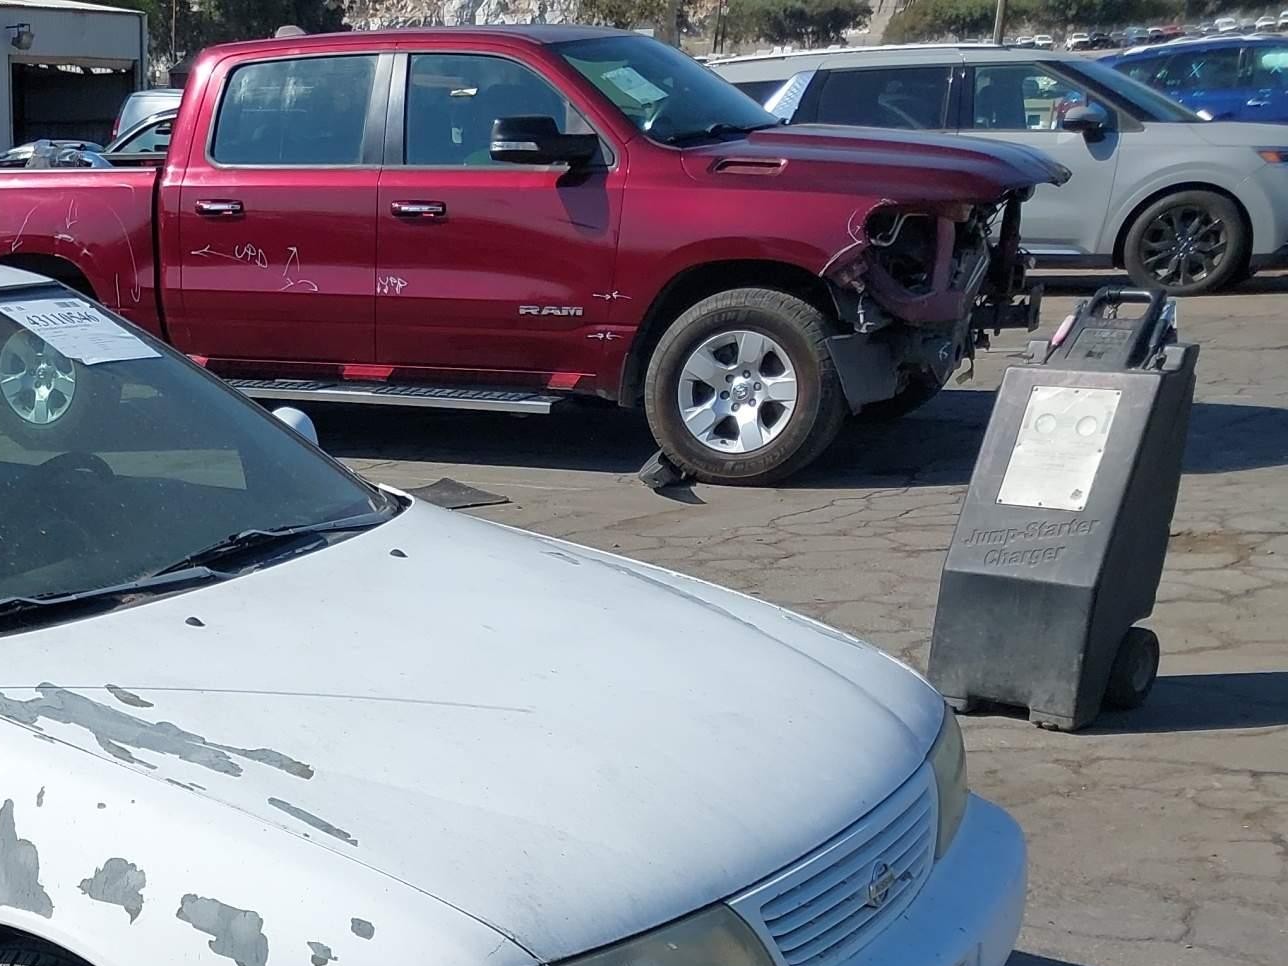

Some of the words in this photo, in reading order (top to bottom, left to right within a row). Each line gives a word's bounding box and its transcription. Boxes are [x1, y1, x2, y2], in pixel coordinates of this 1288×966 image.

[26, 311, 100, 327] 43110546
[519, 305, 584, 316] RAM
[964, 518, 1100, 546] Jump-Starter
[983, 546, 1066, 568] Charger
